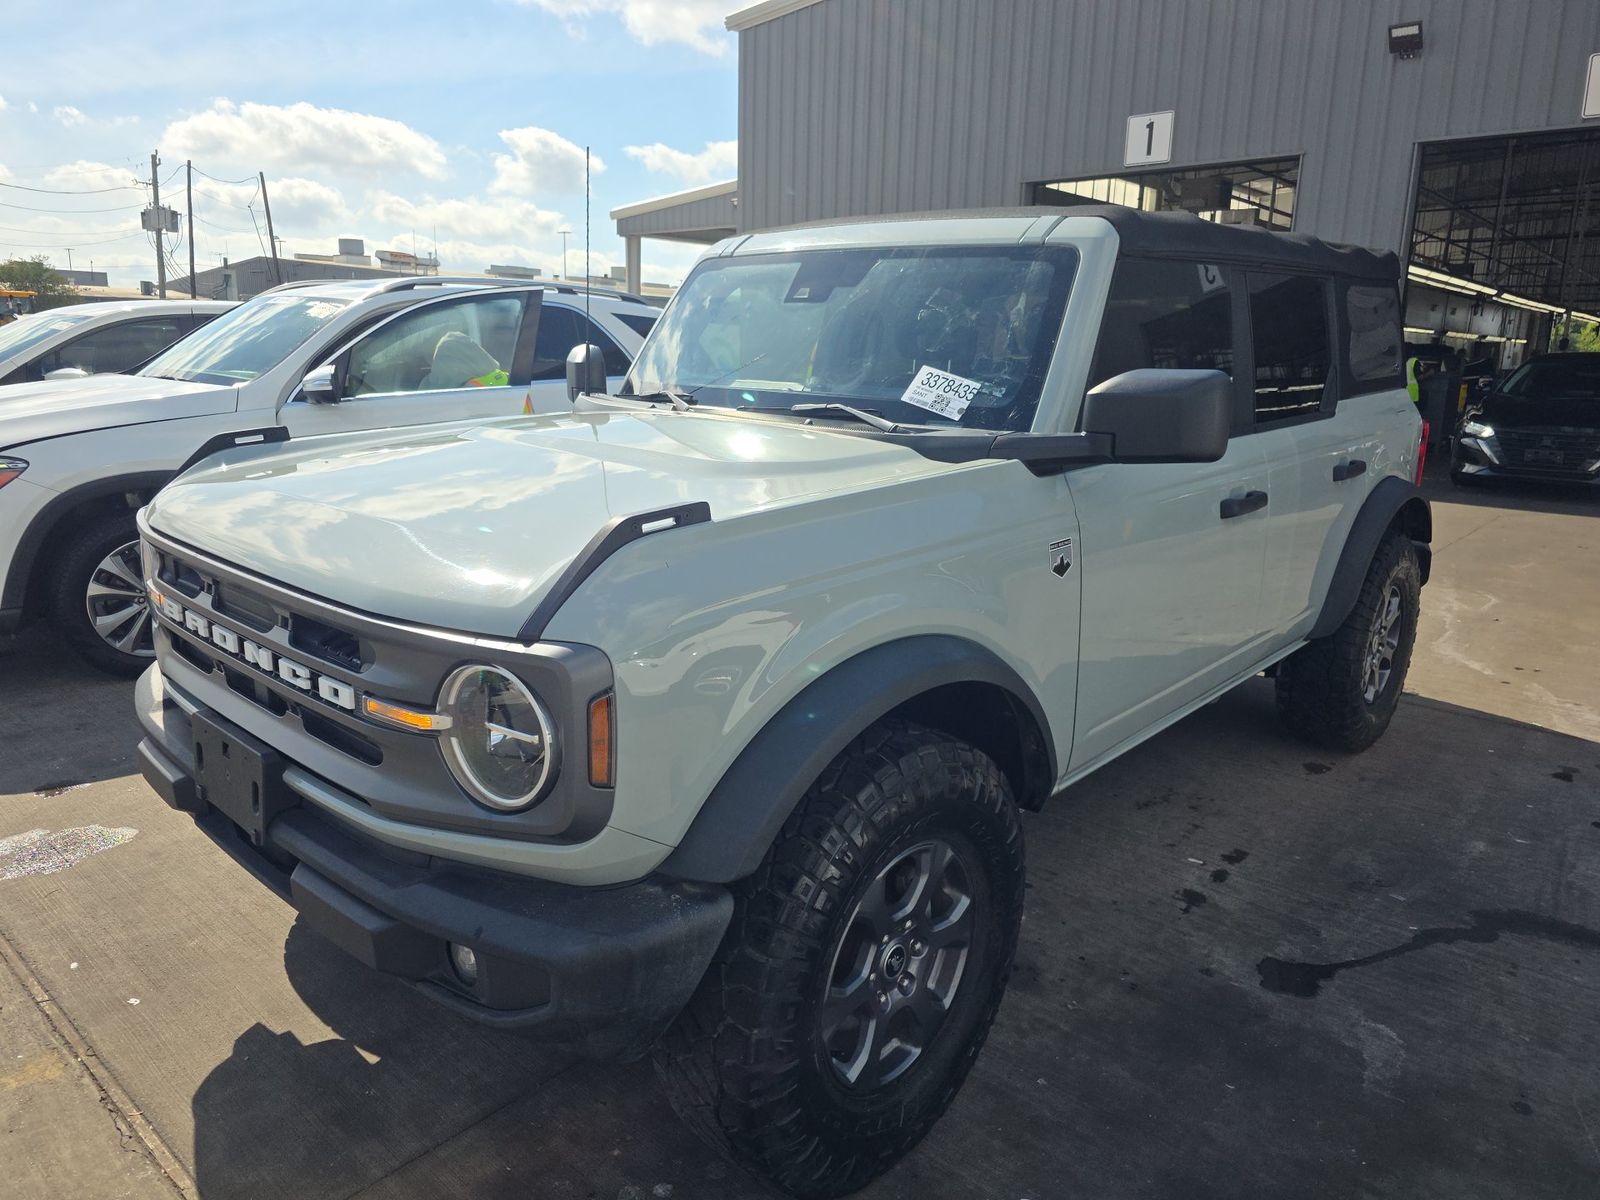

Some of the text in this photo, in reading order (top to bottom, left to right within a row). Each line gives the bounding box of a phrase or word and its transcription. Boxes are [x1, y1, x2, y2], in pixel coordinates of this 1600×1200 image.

[1146, 121, 1154, 156] 1
[921, 372, 978, 401] 3378435
[163, 598, 356, 710] BRONCO
